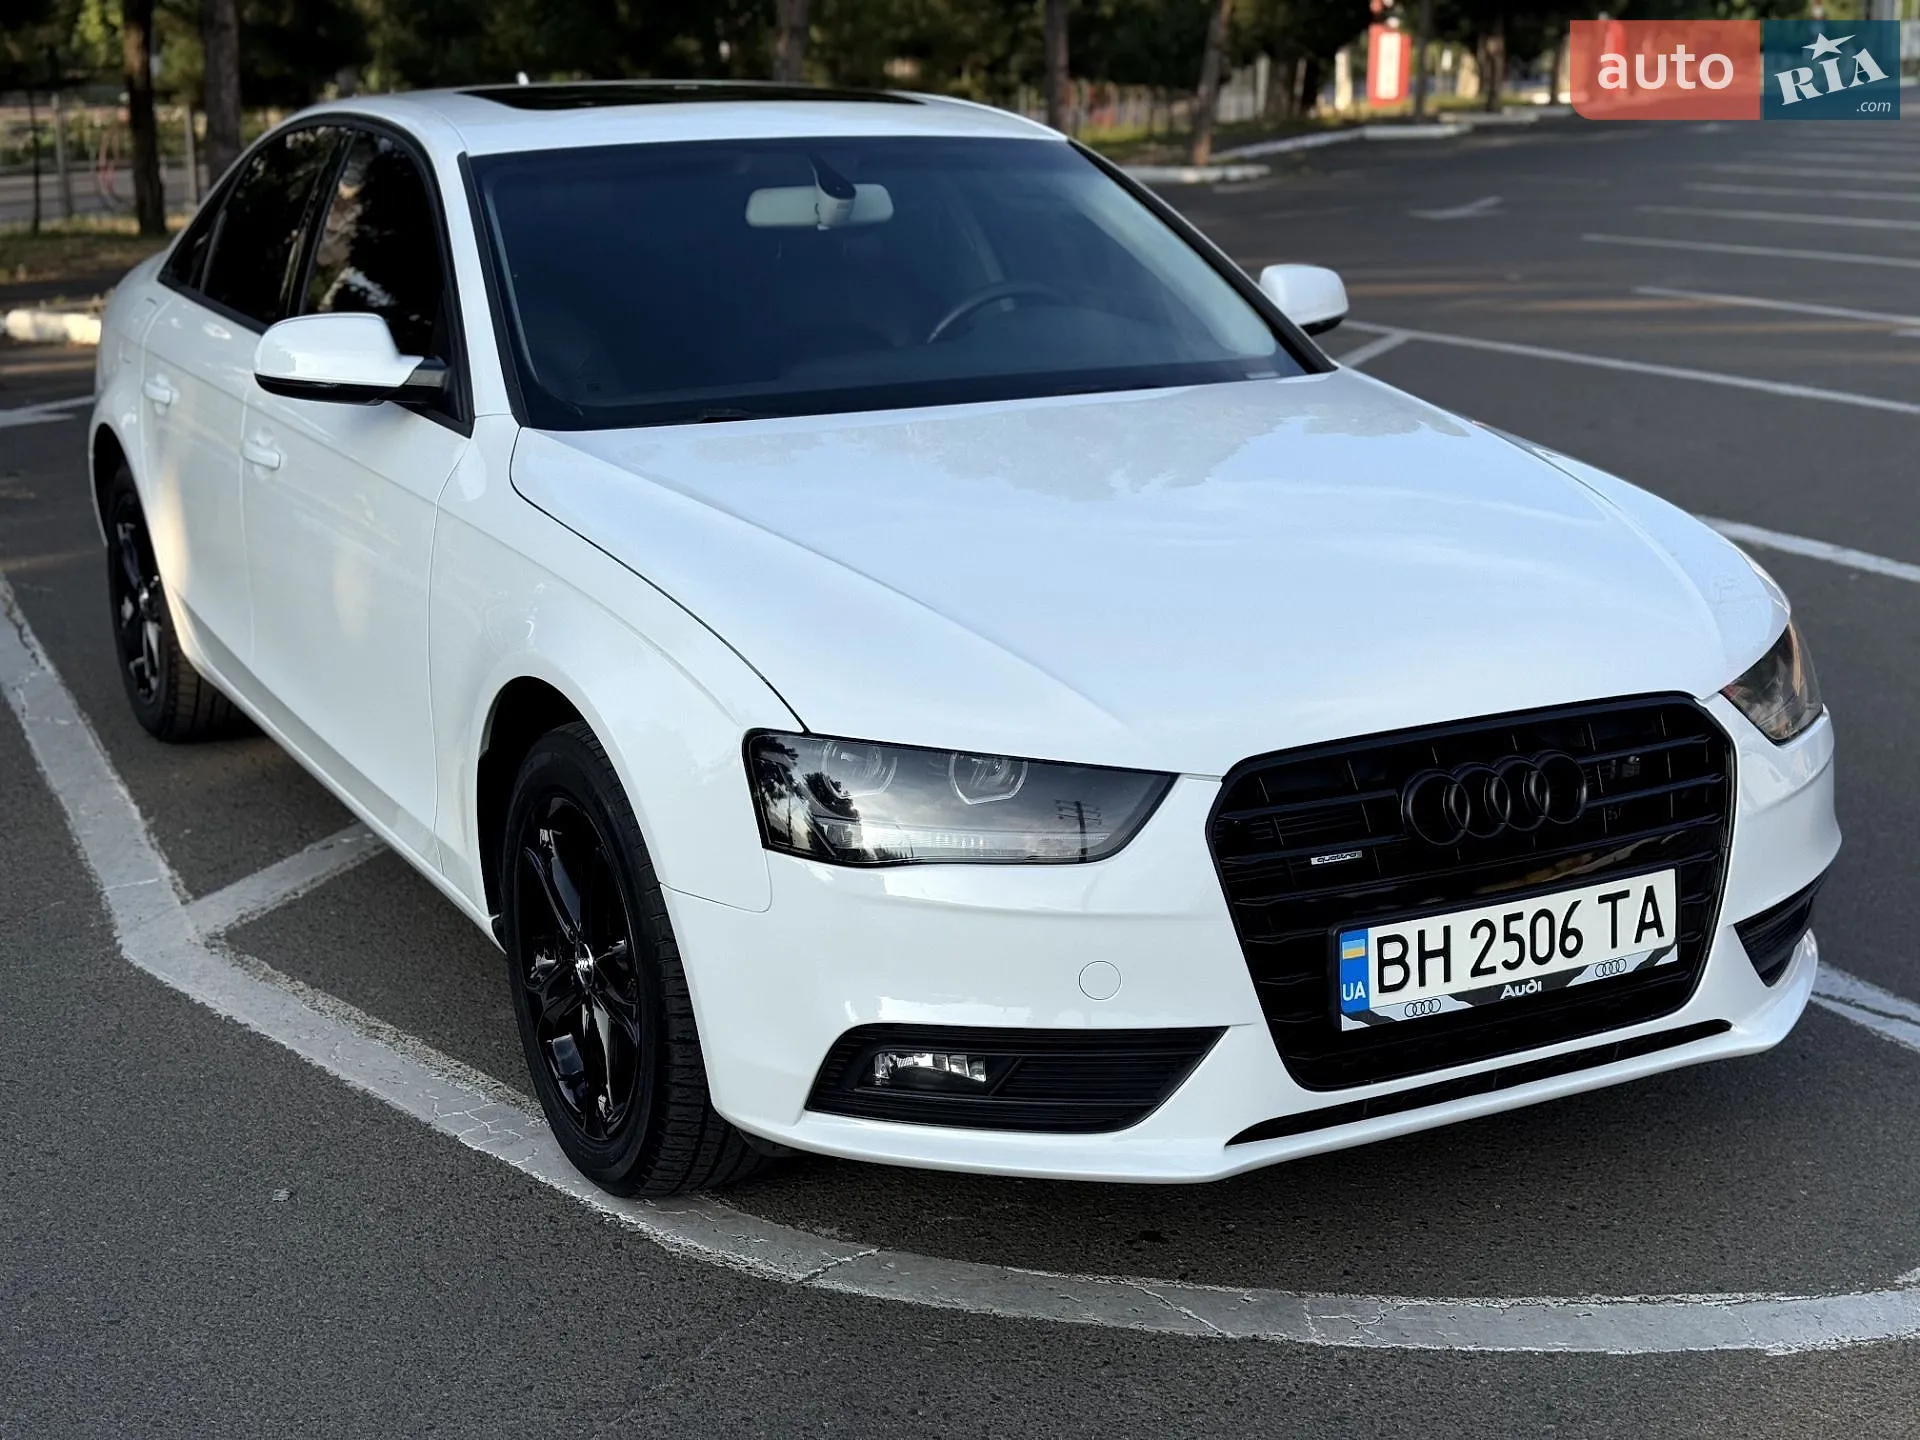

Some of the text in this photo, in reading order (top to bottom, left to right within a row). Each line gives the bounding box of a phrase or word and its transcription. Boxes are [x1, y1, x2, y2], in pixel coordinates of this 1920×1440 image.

[1376, 885, 1665, 995] BH 2506 TA
[1342, 981, 1367, 1001] UA
[1500, 979, 1543, 1000] Audi
